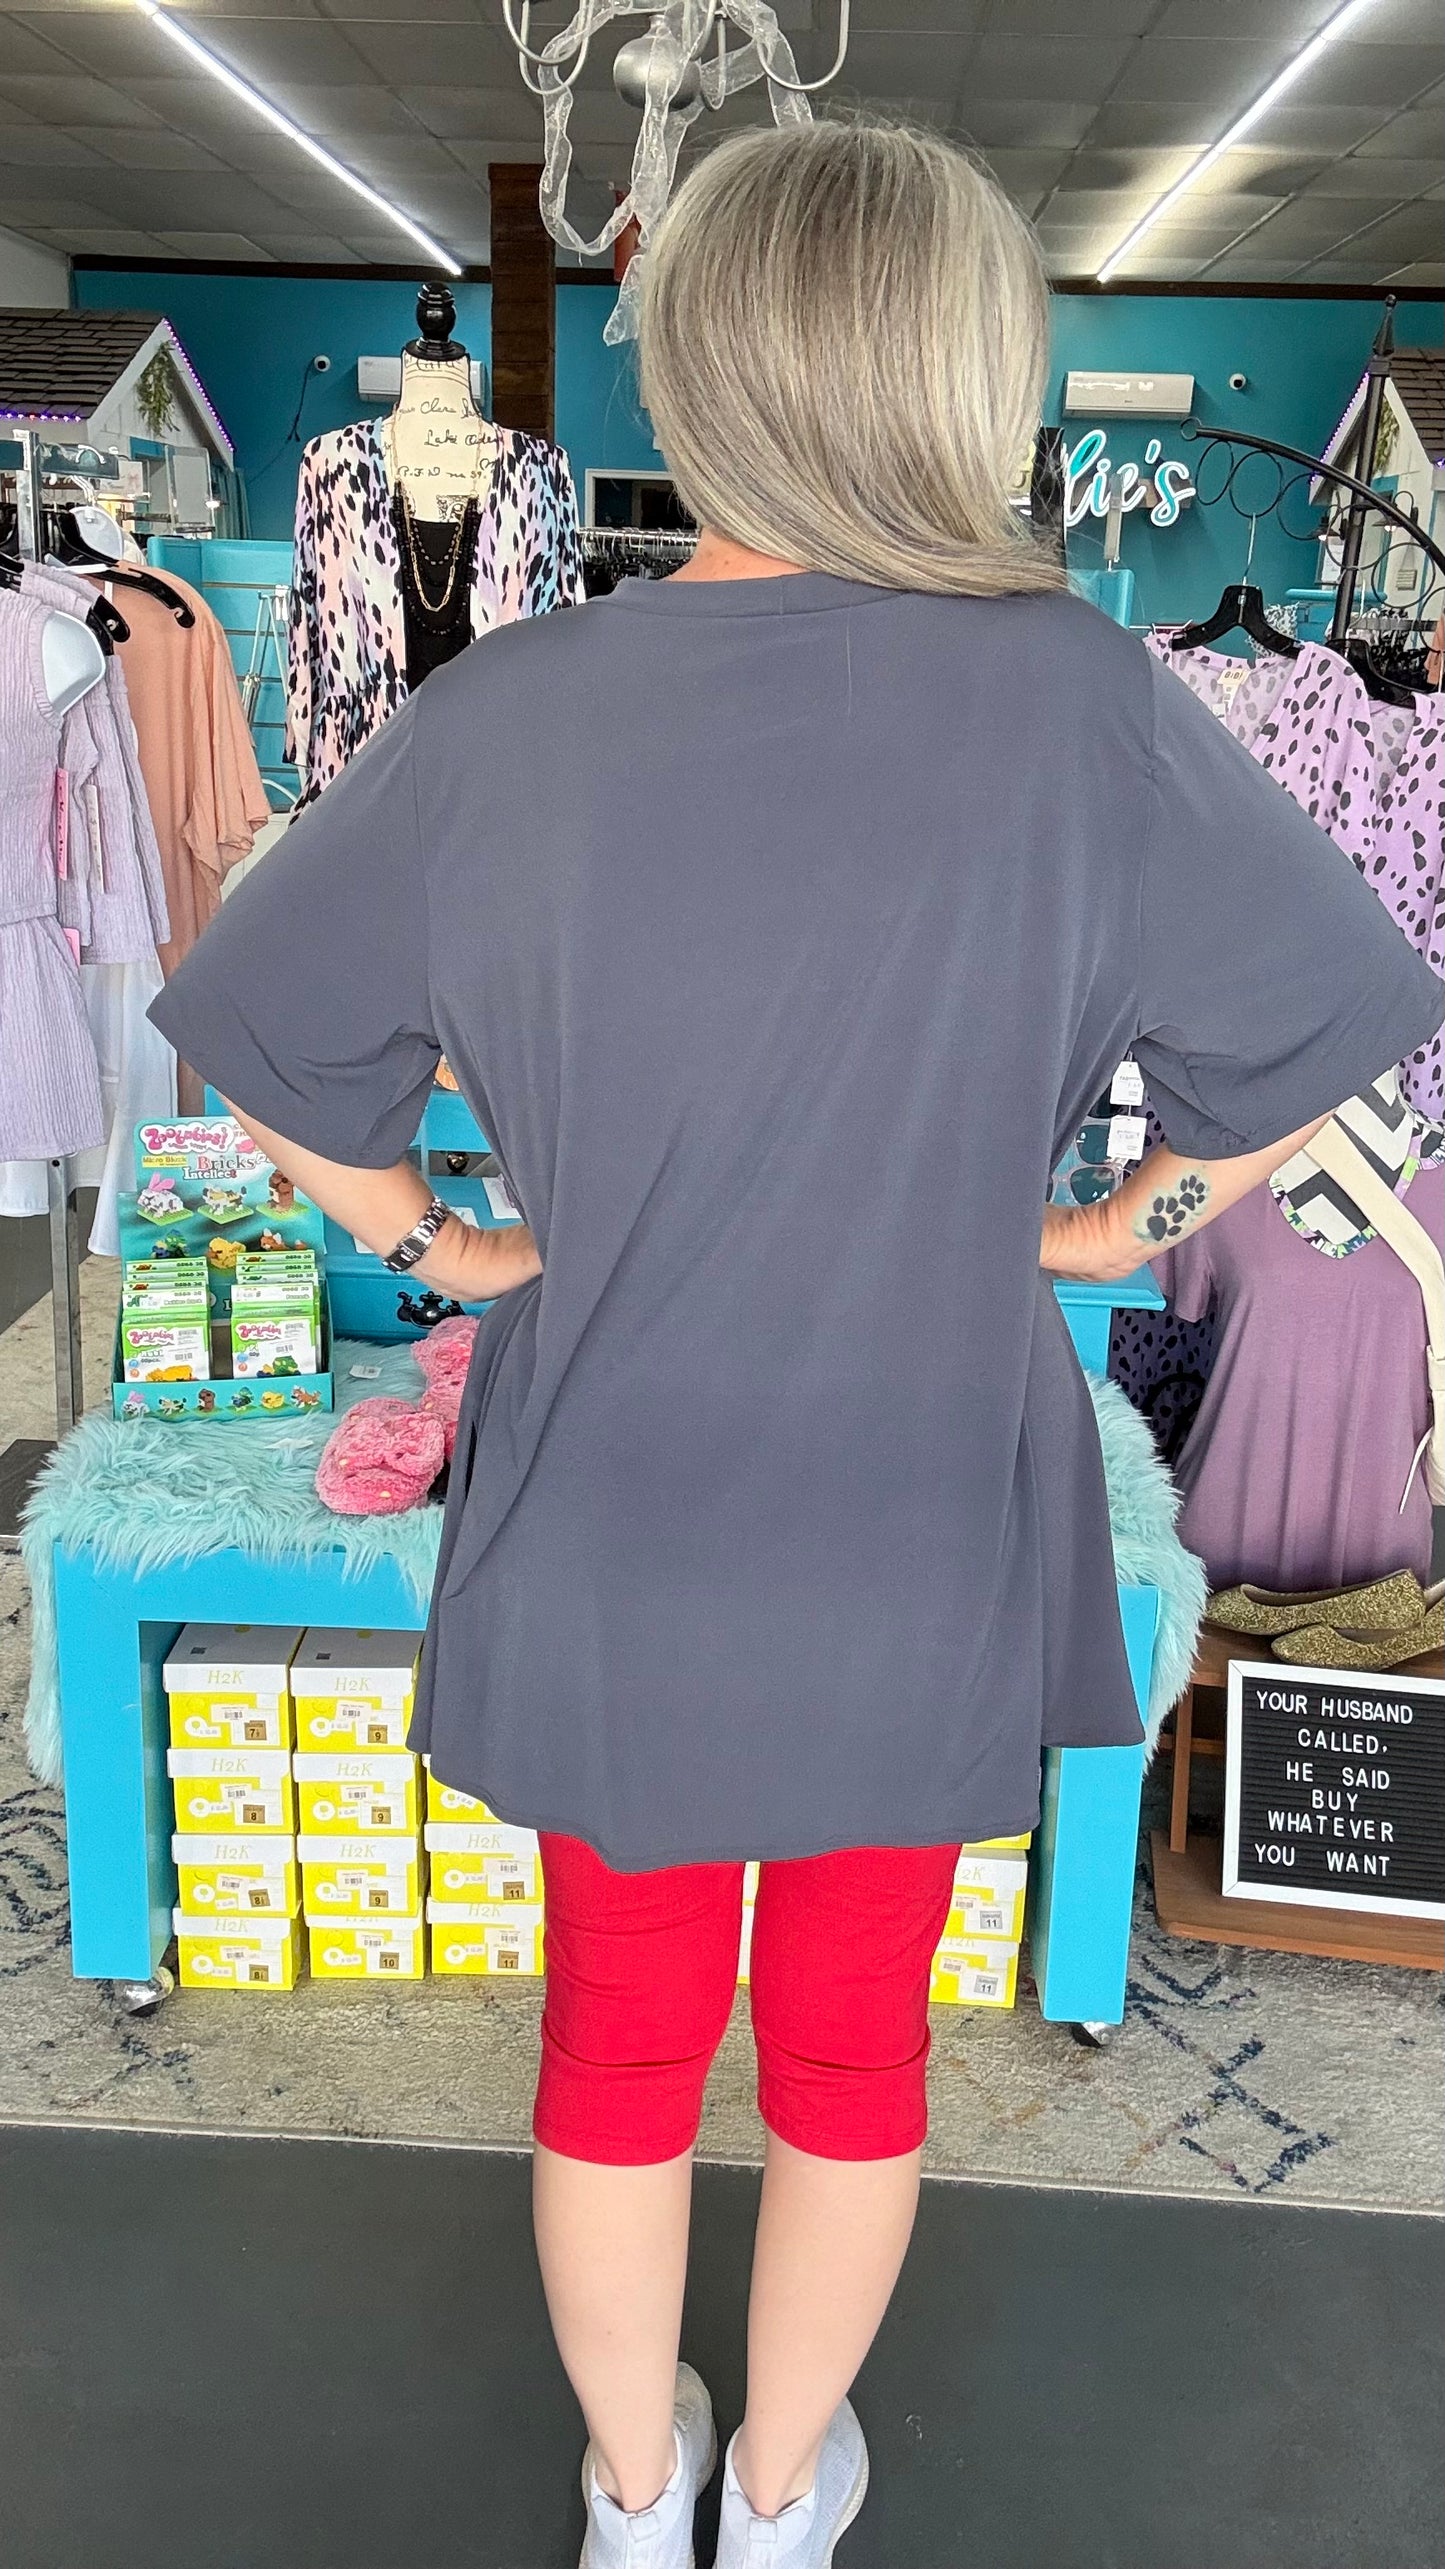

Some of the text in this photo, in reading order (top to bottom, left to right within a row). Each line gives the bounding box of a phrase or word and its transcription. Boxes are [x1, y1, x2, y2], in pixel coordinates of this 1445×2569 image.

[197, 1154, 256, 1171] Bricks
[182, 1167, 238, 1180] Intellect
[208, 1670, 244, 1684] H2K
[335, 1677, 371, 1691] H2K
[1257, 1690, 1413, 1724] YOUR HUSBAND
[212, 1758, 248, 1772] H2K
[337, 1762, 373, 1777] H2K
[1286, 1761, 1390, 1790] HE SAID
[1312, 1789, 1358, 1812] BUY
[1268, 1810, 1394, 1843] WHATEVER
[467, 1833, 503, 1849] H2K
[215, 1845, 251, 1860] H2K
[340, 1844, 377, 1859] H2K
[1254, 1843, 1390, 1877] YOU WANT
[509, 1889, 521, 1898] 11
[215, 1918, 250, 1933] H2K
[986, 1919, 997, 1928] 11
[383, 1959, 395, 1968] 10
[503, 1959, 515, 1968] 11
[981, 1984, 992, 1993] 11
